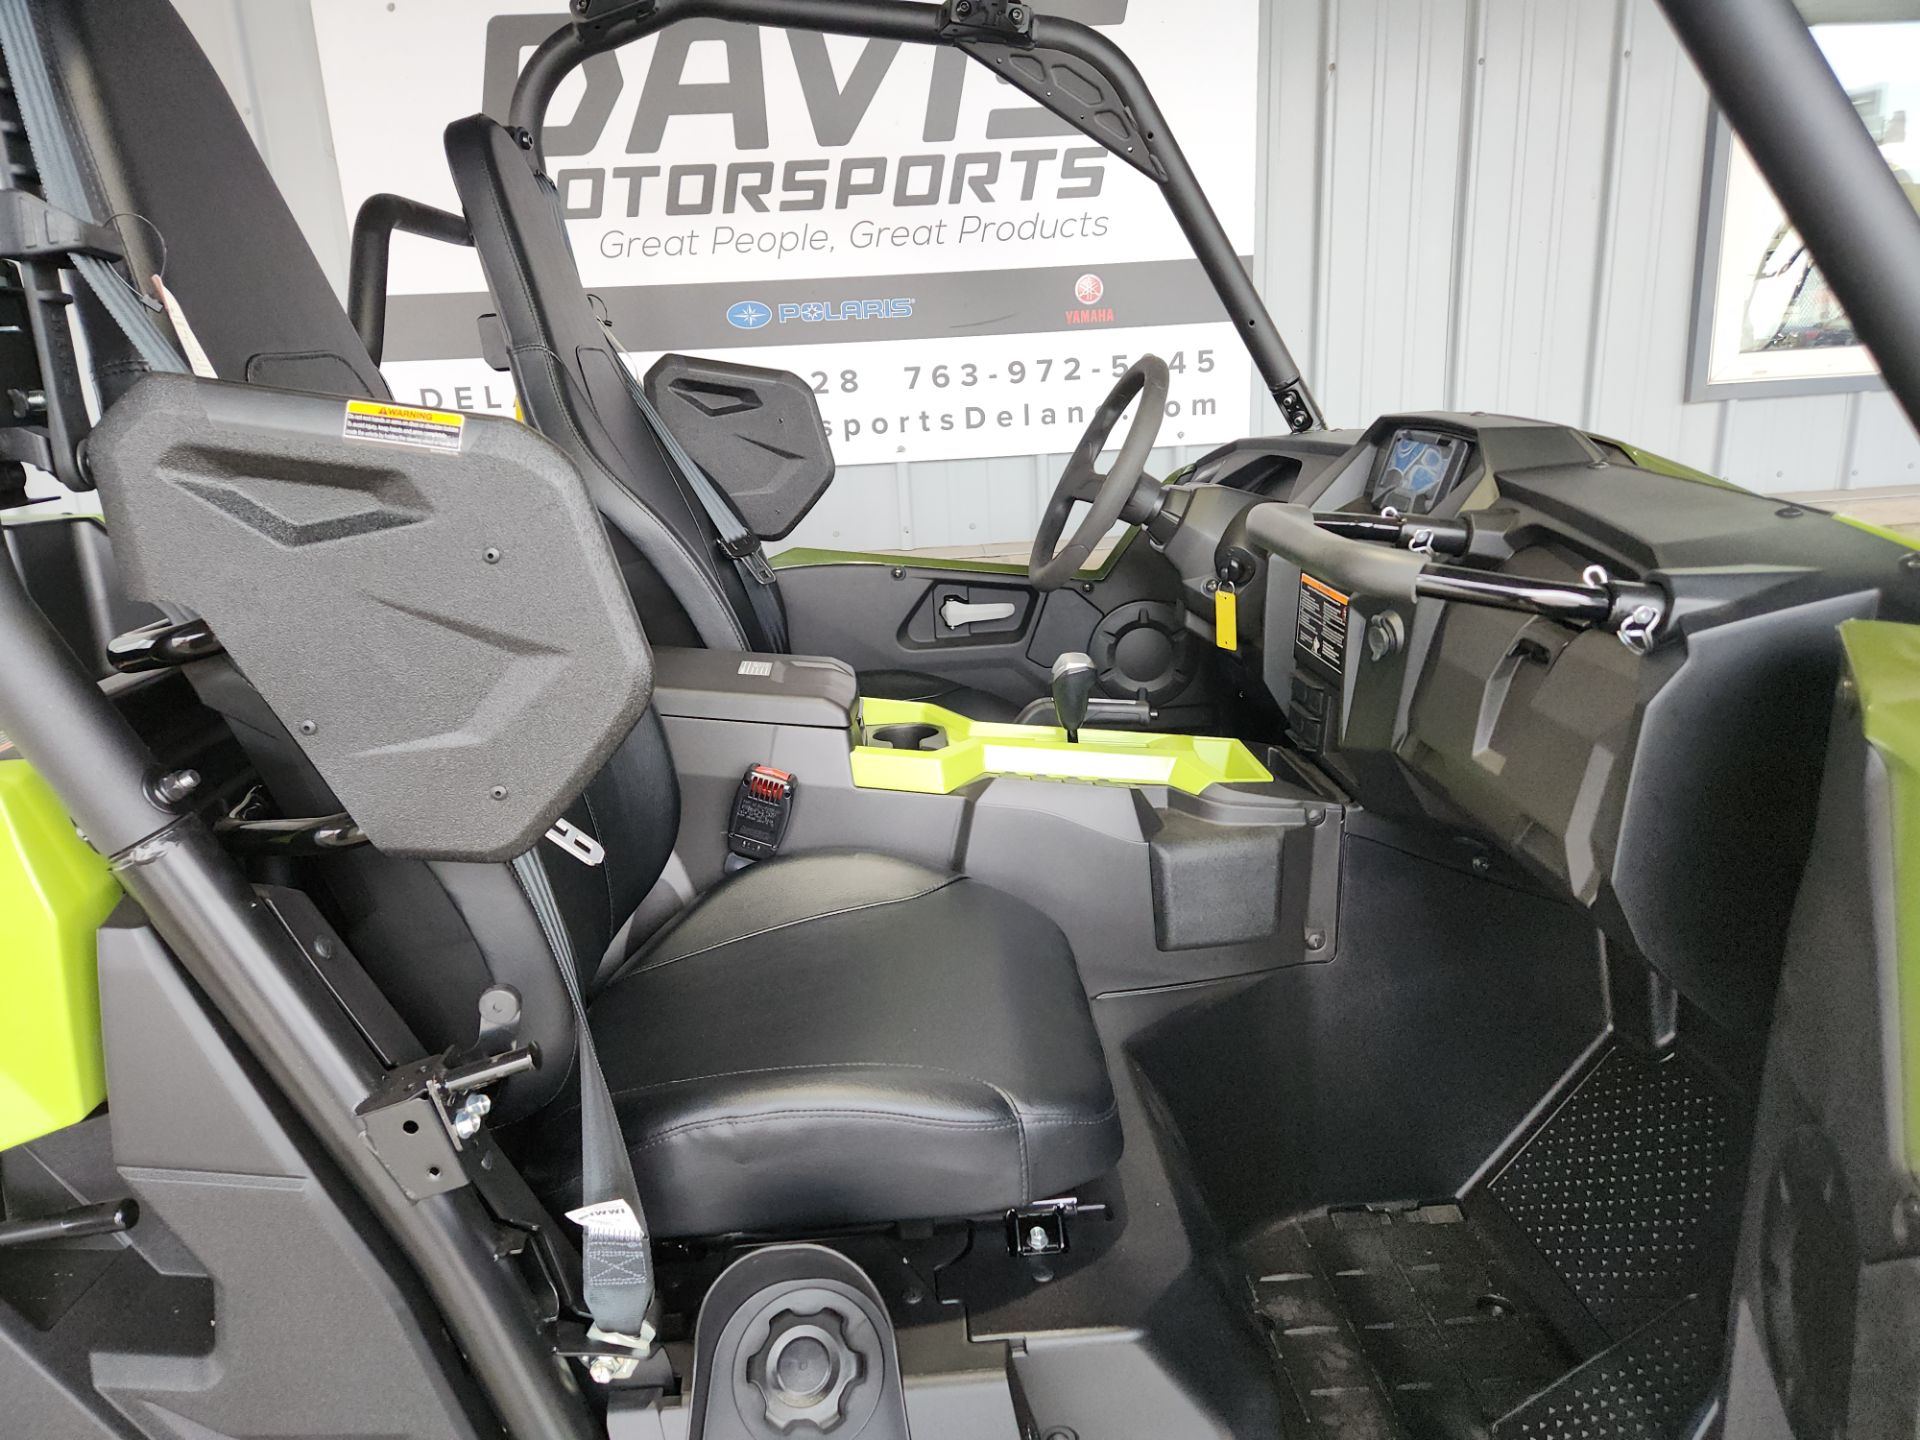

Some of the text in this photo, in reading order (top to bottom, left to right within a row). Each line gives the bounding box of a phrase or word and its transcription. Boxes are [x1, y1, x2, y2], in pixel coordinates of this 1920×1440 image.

[556, 146, 1108, 220] OTORSPORTS
[600, 211, 1110, 260] Great People, Great Products
[778, 298, 913, 324] POLARIS
[1065, 307, 1114, 325] YAMAHA
[420, 385, 516, 409] DEL
[903, 349, 1215, 390] 763-972-545
[388, 408, 433, 421] WARNING
[822, 396, 1217, 443] sportsDelan.om
